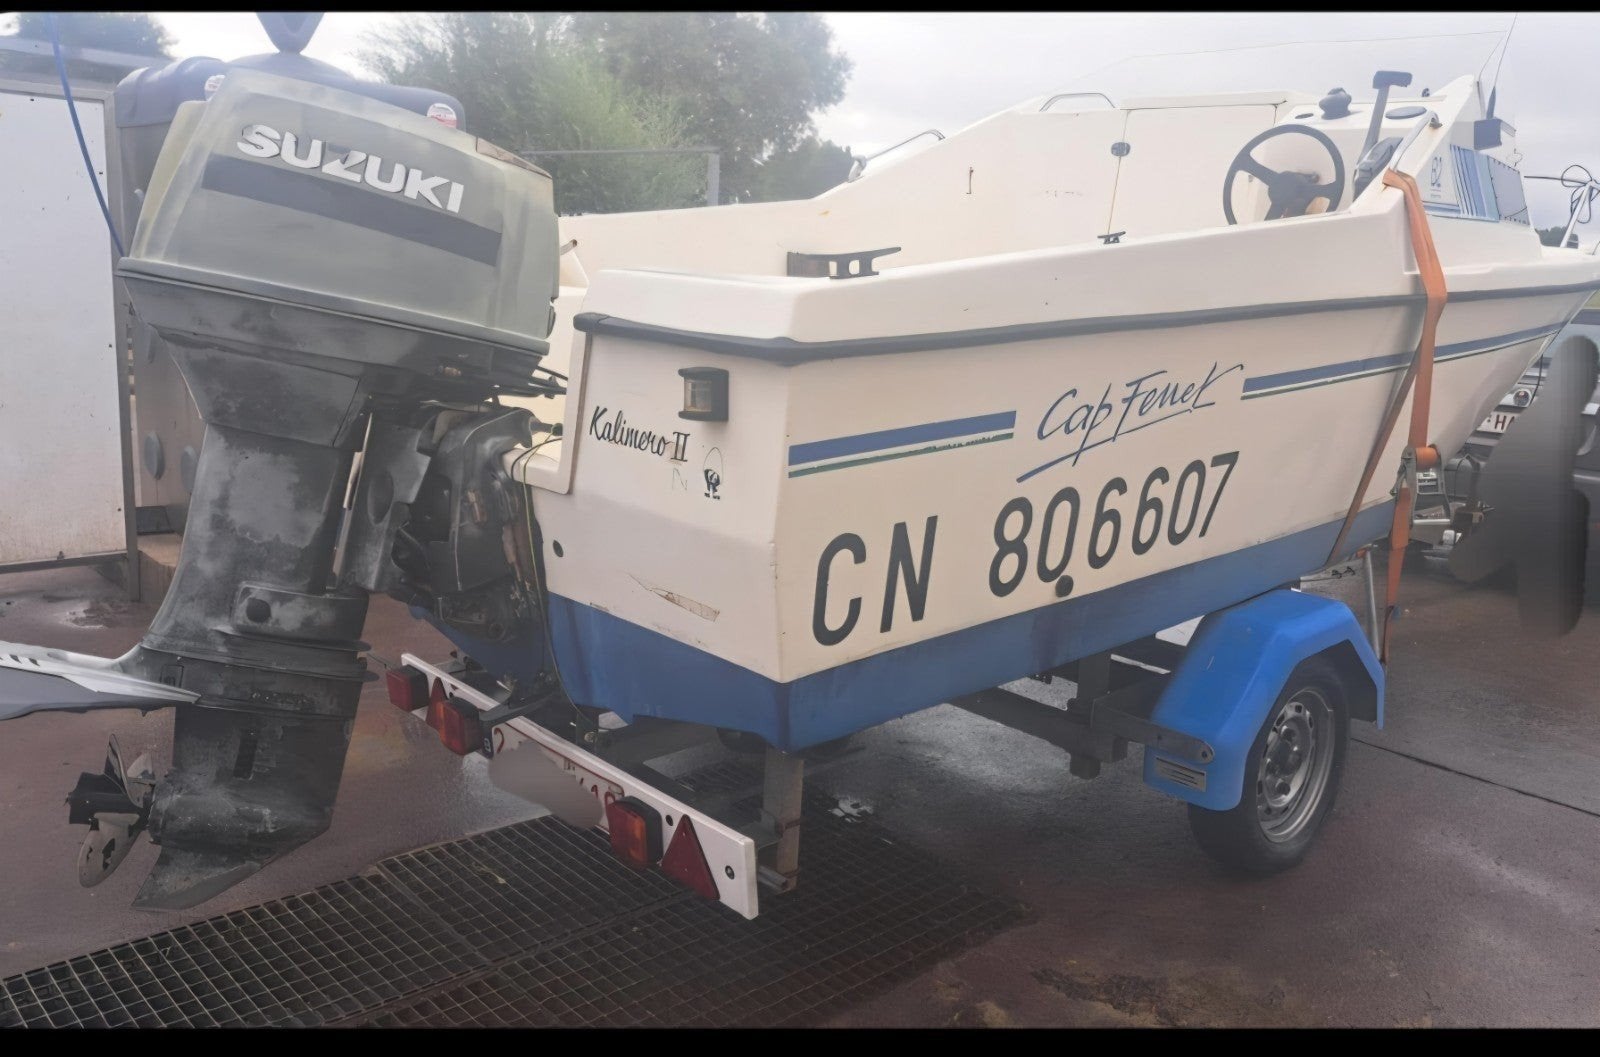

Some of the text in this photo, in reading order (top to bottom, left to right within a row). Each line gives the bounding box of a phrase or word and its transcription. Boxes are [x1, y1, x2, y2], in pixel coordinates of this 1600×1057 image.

[237, 124, 464, 213] SUZUKI
[589, 405, 691, 462] Kalimero II
[1037, 383, 1113, 467] Cap
[812, 450, 1240, 646] CN 806607
